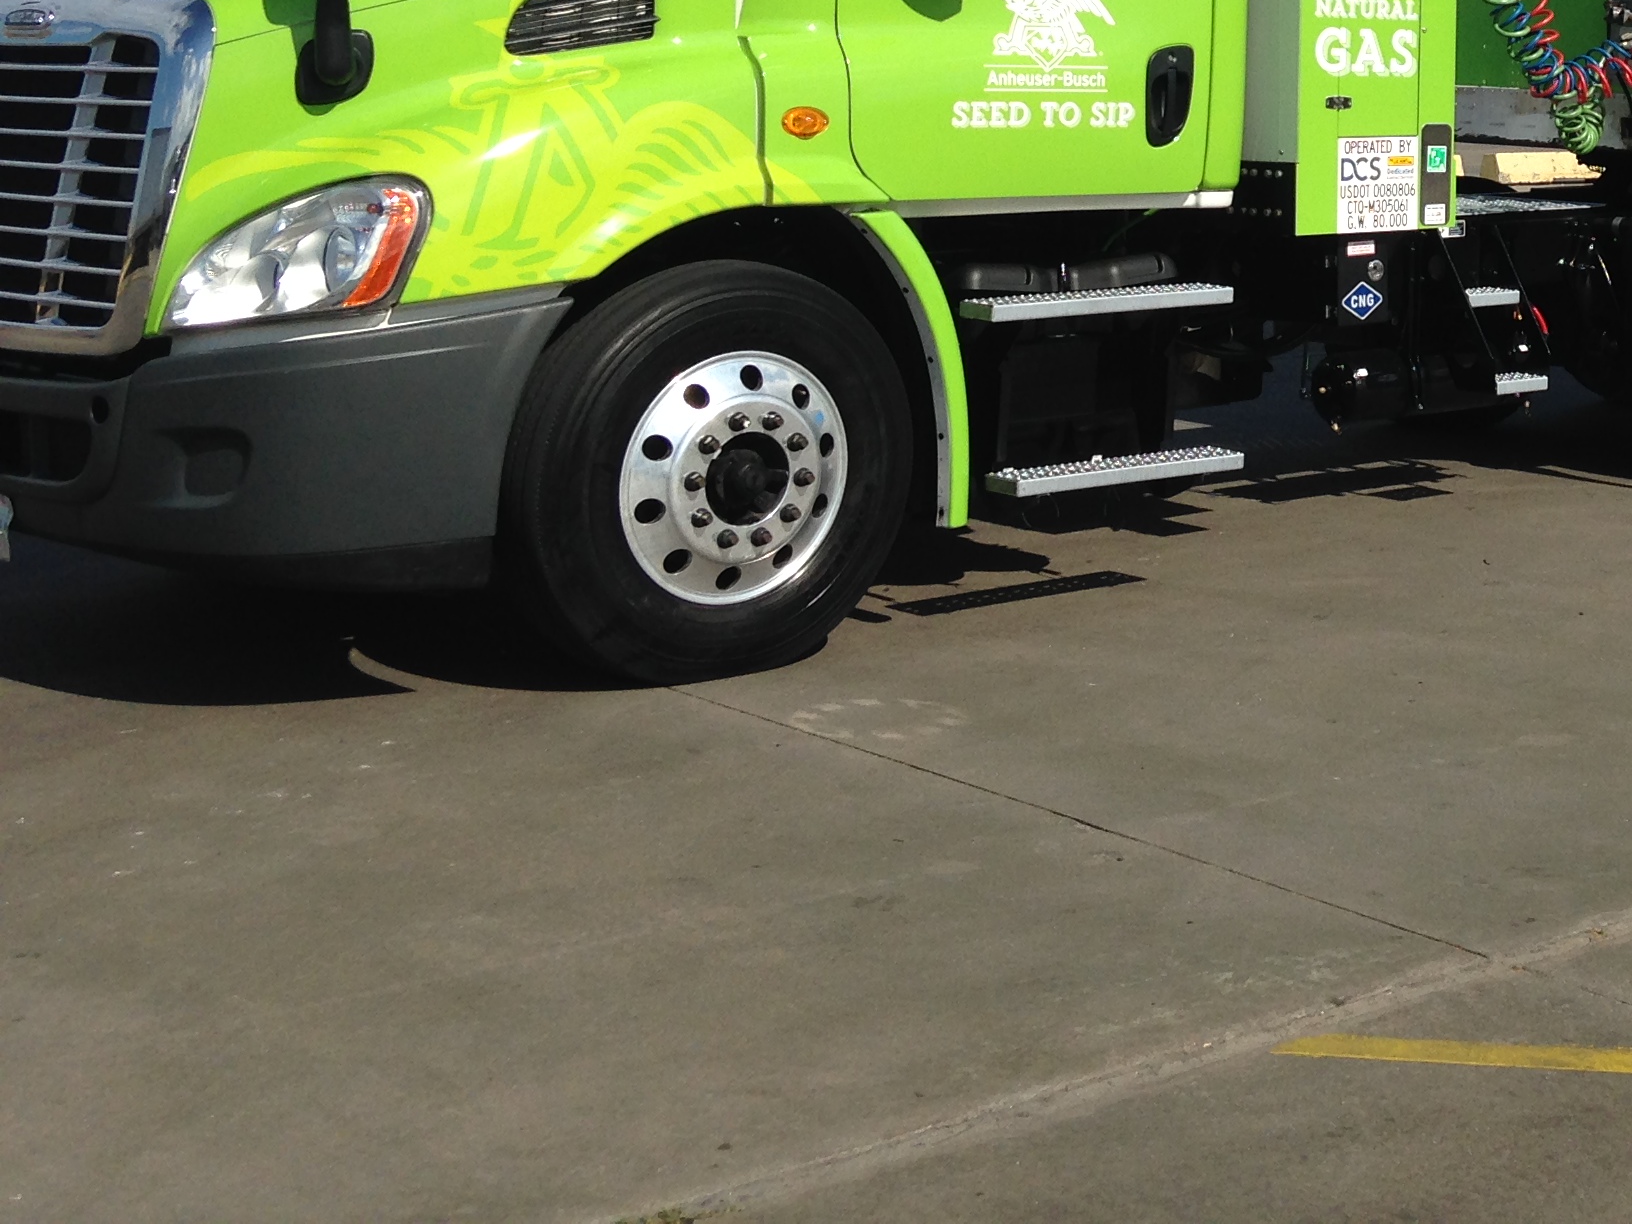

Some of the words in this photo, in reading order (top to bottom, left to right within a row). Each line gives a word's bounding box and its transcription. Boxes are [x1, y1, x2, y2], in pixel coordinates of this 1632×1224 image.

[1314, 26, 1418, 78] GAS
[986, 70, 1106, 88] Anheuser-Busch
[951, 100, 1032, 129] SEED
[1040, 101, 1082, 129] TO
[1089, 101, 1136, 129] SIP
[1344, 140, 1393, 155] OPERATED
[1399, 139, 1412, 153] BY
[1340, 157, 1381, 181] DCS
[1340, 184, 1371, 199] USDOT
[1373, 182, 1416, 198] 0080806
[1350, 293, 1375, 309] CNG
